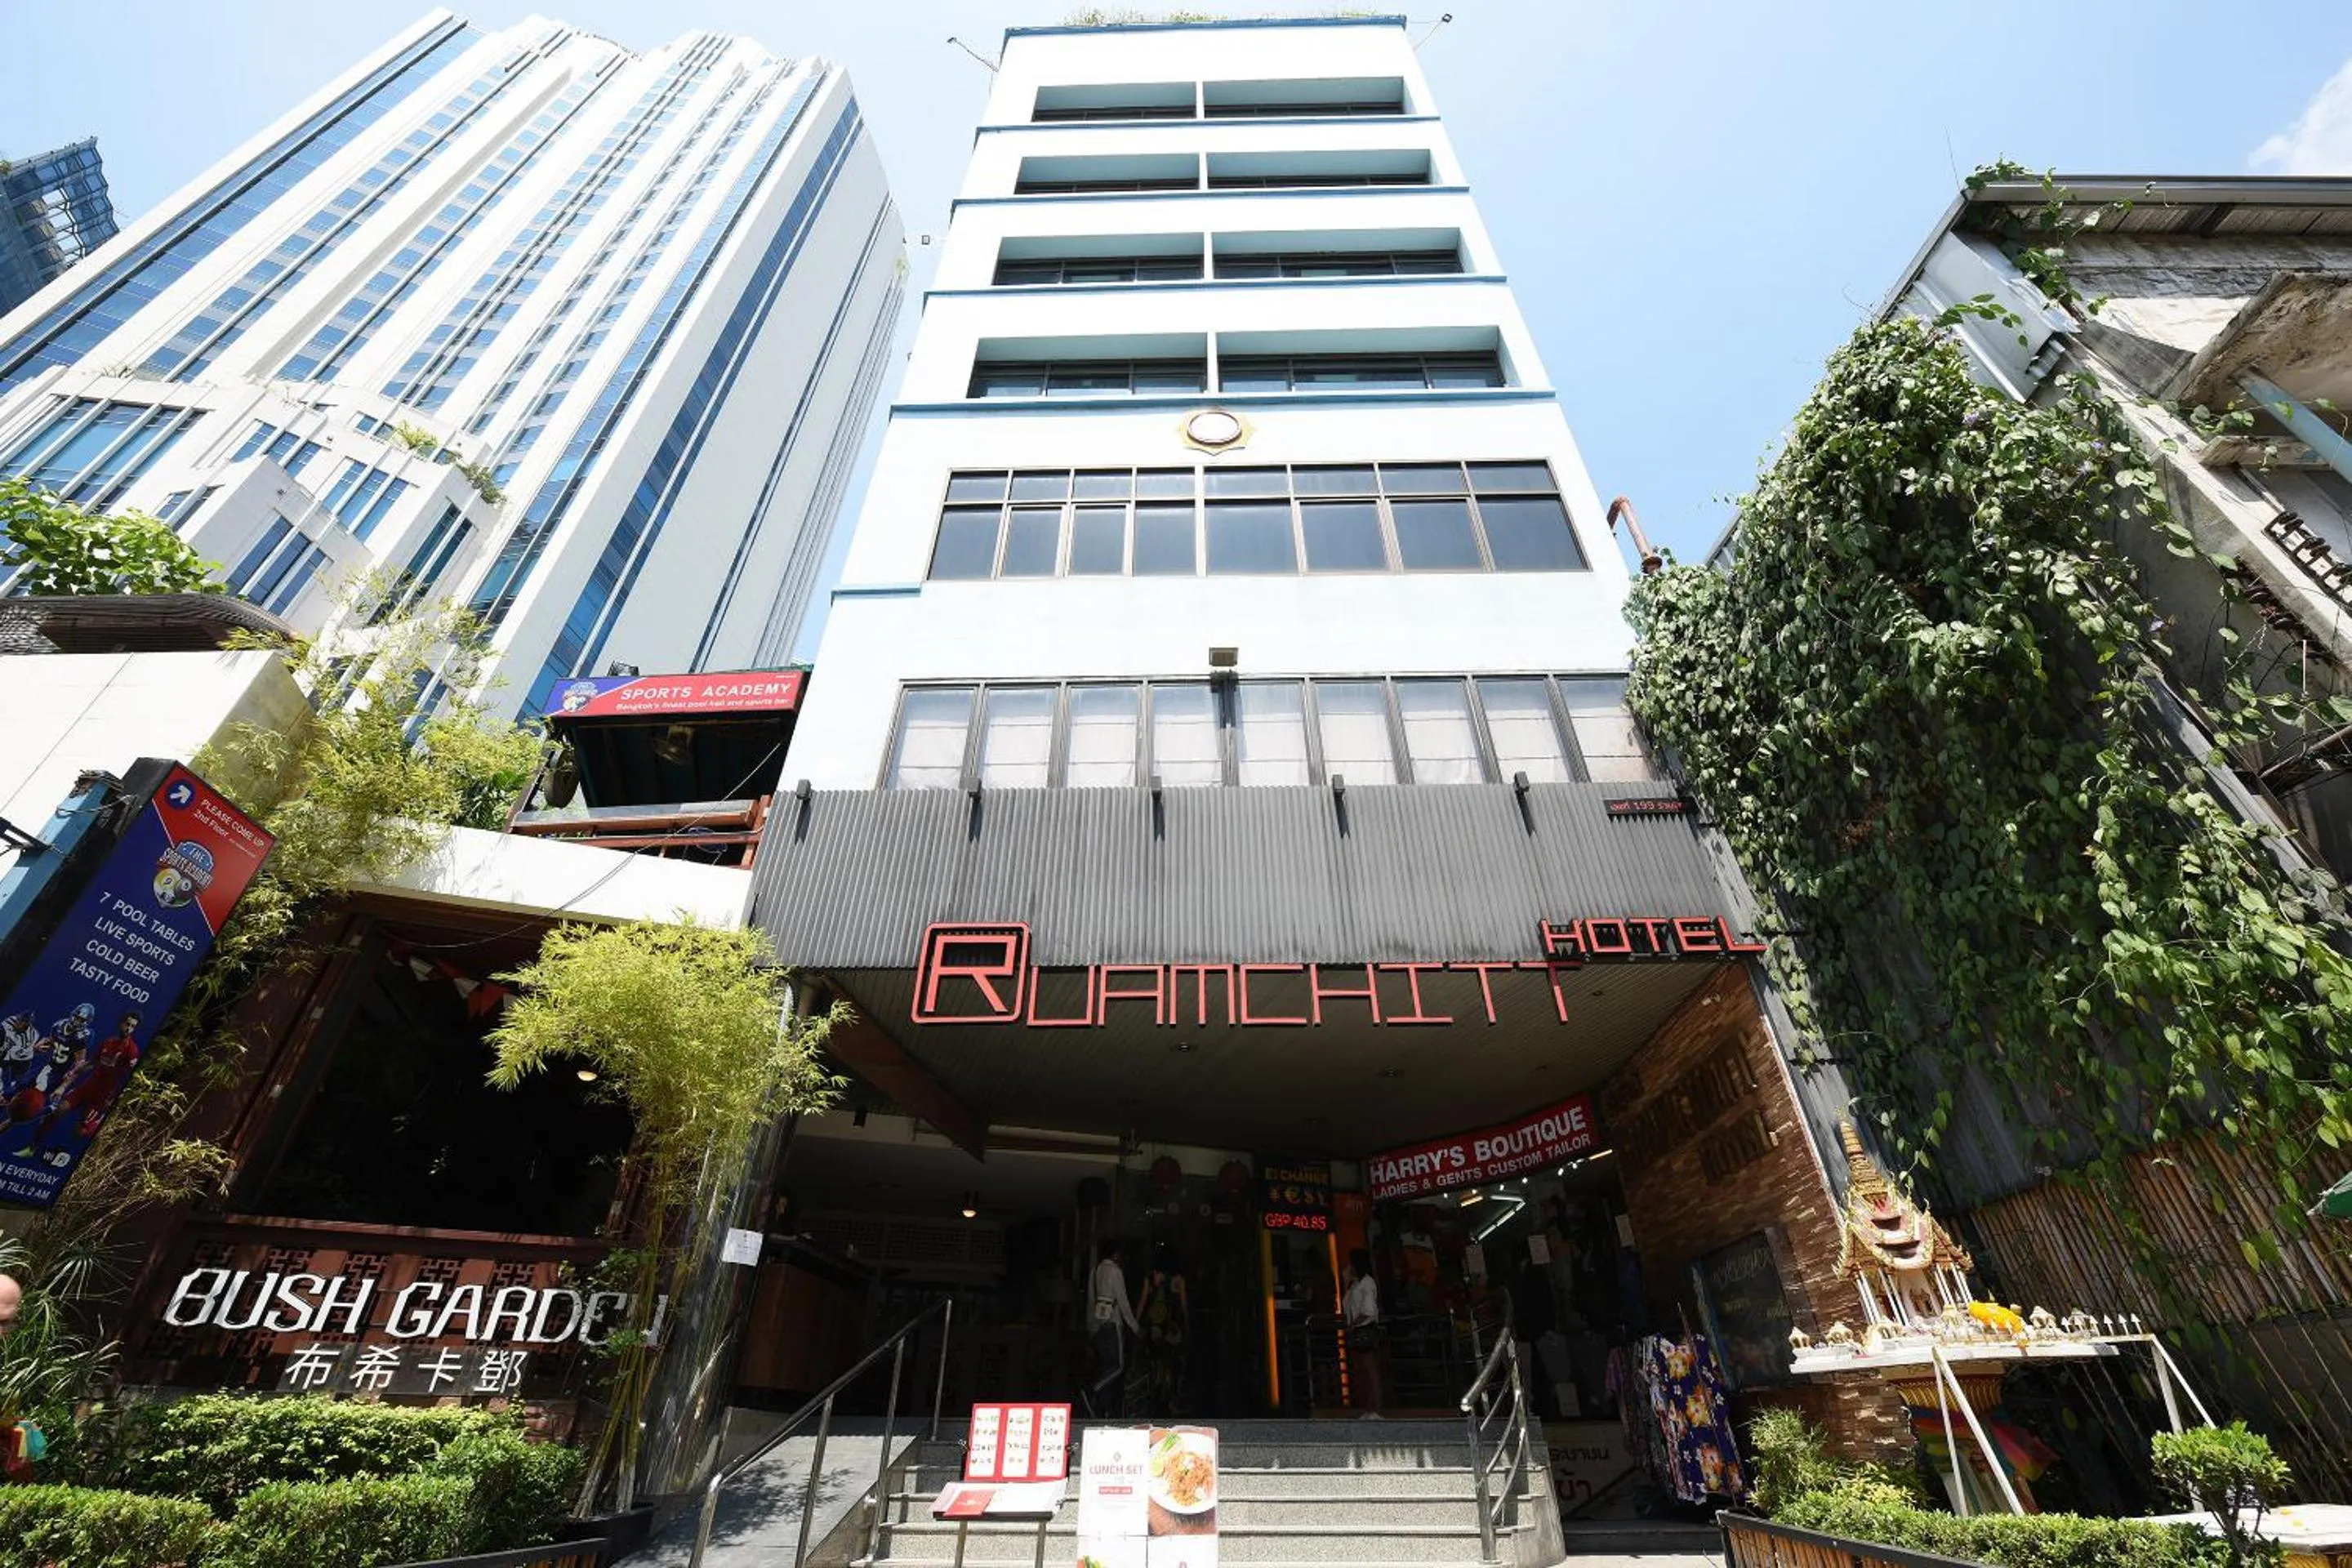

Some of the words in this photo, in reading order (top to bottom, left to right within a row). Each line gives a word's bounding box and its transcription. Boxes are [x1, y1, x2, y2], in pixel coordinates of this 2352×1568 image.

[621, 686, 692, 700] SPORTS
[702, 682, 791, 697] ACADEMY
[201, 799, 233, 826] PLEASE
[231, 821, 253, 842] COME
[253, 836, 265, 848] UP
[94, 916, 127, 940] LIVE
[126, 933, 176, 965] SPORTS
[100, 891, 111, 903] 7
[113, 899, 147, 928] POOL
[149, 919, 195, 951] TABLES
[1539, 915, 1768, 954] HOTEL
[69, 957, 114, 986] TASTY
[112, 979, 150, 1003] FOOD
[86, 939, 124, 965] COLD
[123, 958, 160, 983] BEER
[913, 923, 1583, 1027] RUAMCHITT
[1370, 1145, 1466, 1184] HARRY'S
[1473, 1105, 1587, 1162] BOUTIQUE
[1372, 1180, 1419, 1200] LADIES
[1423, 1178, 1431, 1190] &
[1437, 1167, 1482, 1187] GENTS
[1487, 1150, 1543, 1176] CUSTOM
[1545, 1133, 1591, 1160] TAILOR
[5, 1164, 60, 1185] EVERYDAY
[7, 1182, 26, 1196] TILL
[33, 1189, 51, 1200] AM
[1264, 1211, 1291, 1228] GBP
[163, 1267, 375, 1334] BUSH
[1089, 1464, 1124, 1475] LUNCH
[1125, 1464, 1143, 1475] SET
